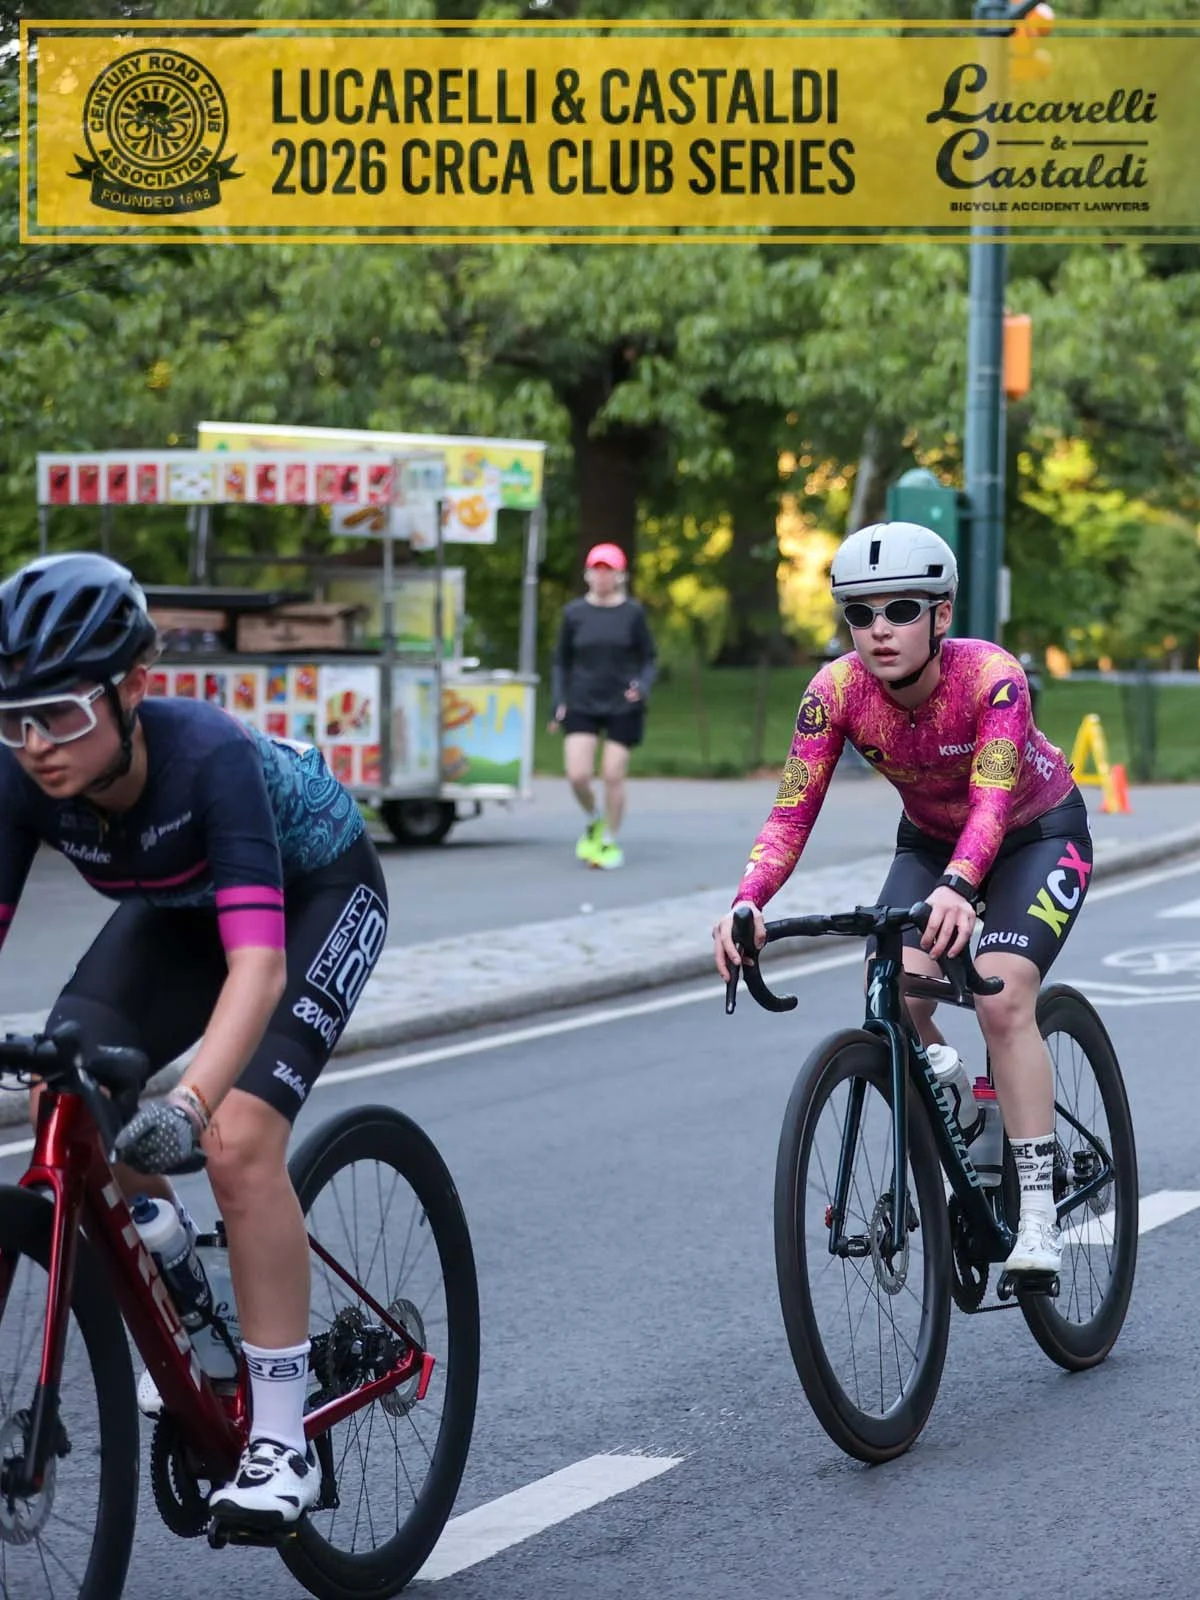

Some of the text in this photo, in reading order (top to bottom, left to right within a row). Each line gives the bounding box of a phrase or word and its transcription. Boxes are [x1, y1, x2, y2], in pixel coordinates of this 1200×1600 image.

[312, 888, 369, 981] TWENTY
[336, 909, 386, 1009] 28
[979, 931, 1029, 949] KRUIS
